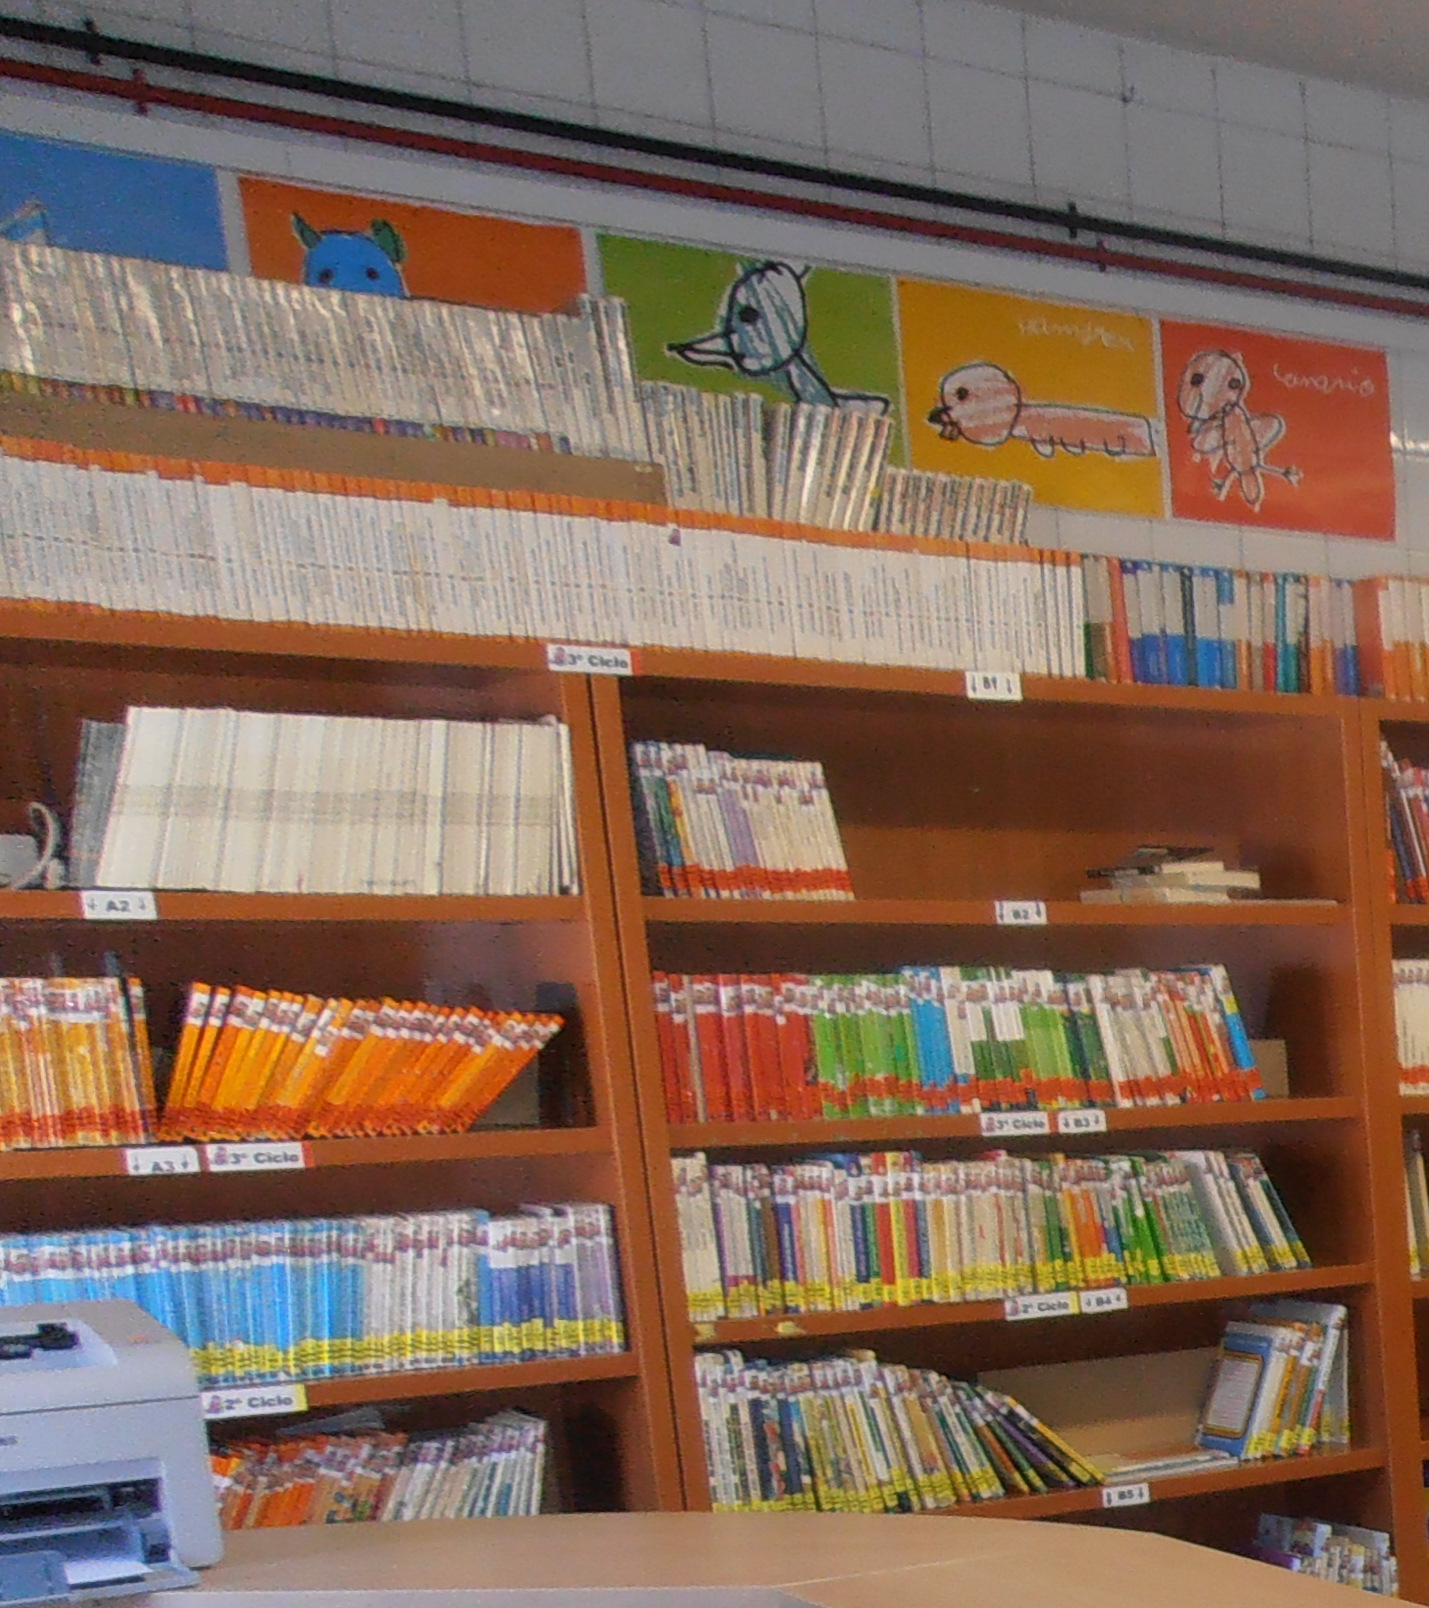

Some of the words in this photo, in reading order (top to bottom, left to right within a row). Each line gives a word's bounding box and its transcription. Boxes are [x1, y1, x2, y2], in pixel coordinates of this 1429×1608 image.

[588, 655, 629, 669] Ciclo
[106, 900, 130, 912] A2
[1012, 1119, 1046, 1130] Ciclo
[254, 1151, 300, 1164] Ciclo
[151, 1161, 176, 1174] A3
[1037, 1300, 1070, 1313] Ciclo
[247, 1395, 293, 1408] Ciclo
